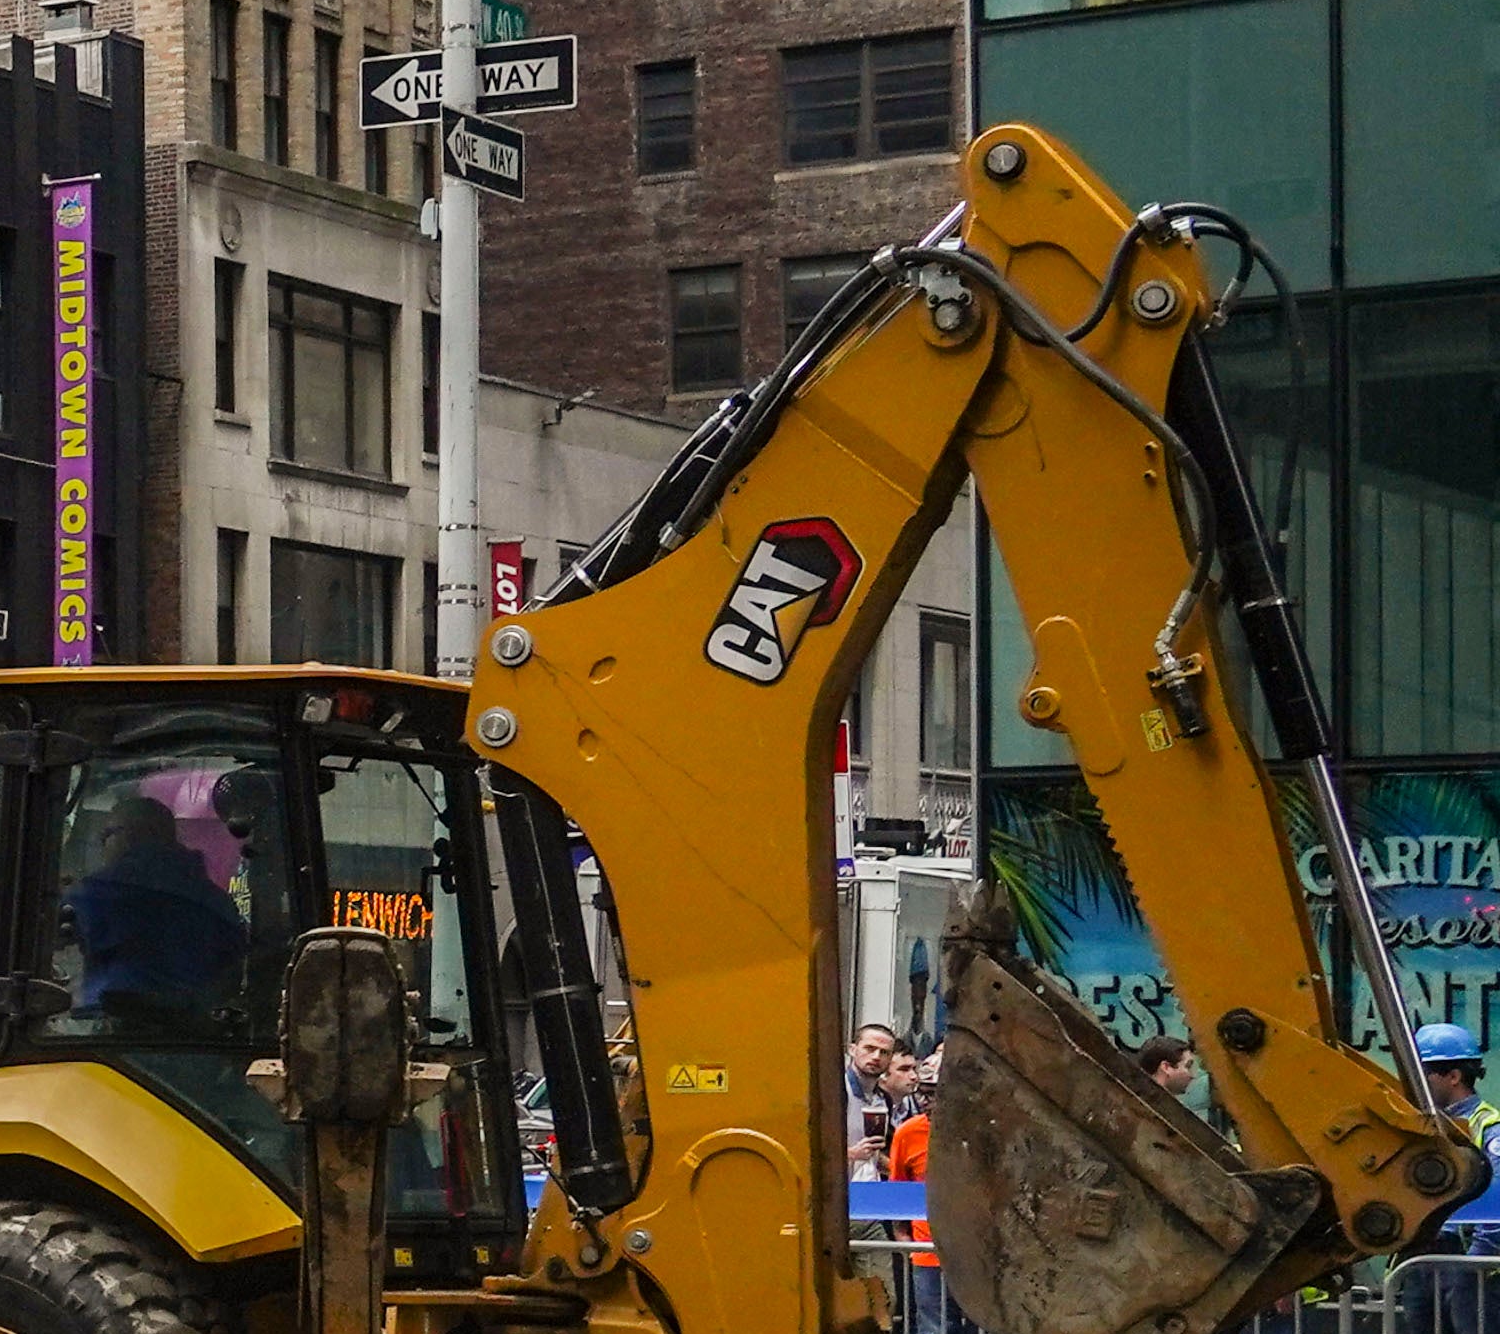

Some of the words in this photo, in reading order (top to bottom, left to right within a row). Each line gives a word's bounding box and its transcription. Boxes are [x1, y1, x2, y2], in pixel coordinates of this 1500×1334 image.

[393, 72, 443, 103] ONE
[480, 61, 545, 93] WAY
[454, 134, 479, 164] ONE
[489, 146, 514, 174] WAY
[58, 241, 88, 459] MIDTOWN
[58, 478, 88, 644] COMICS
[707, 540, 828, 682] CAT
